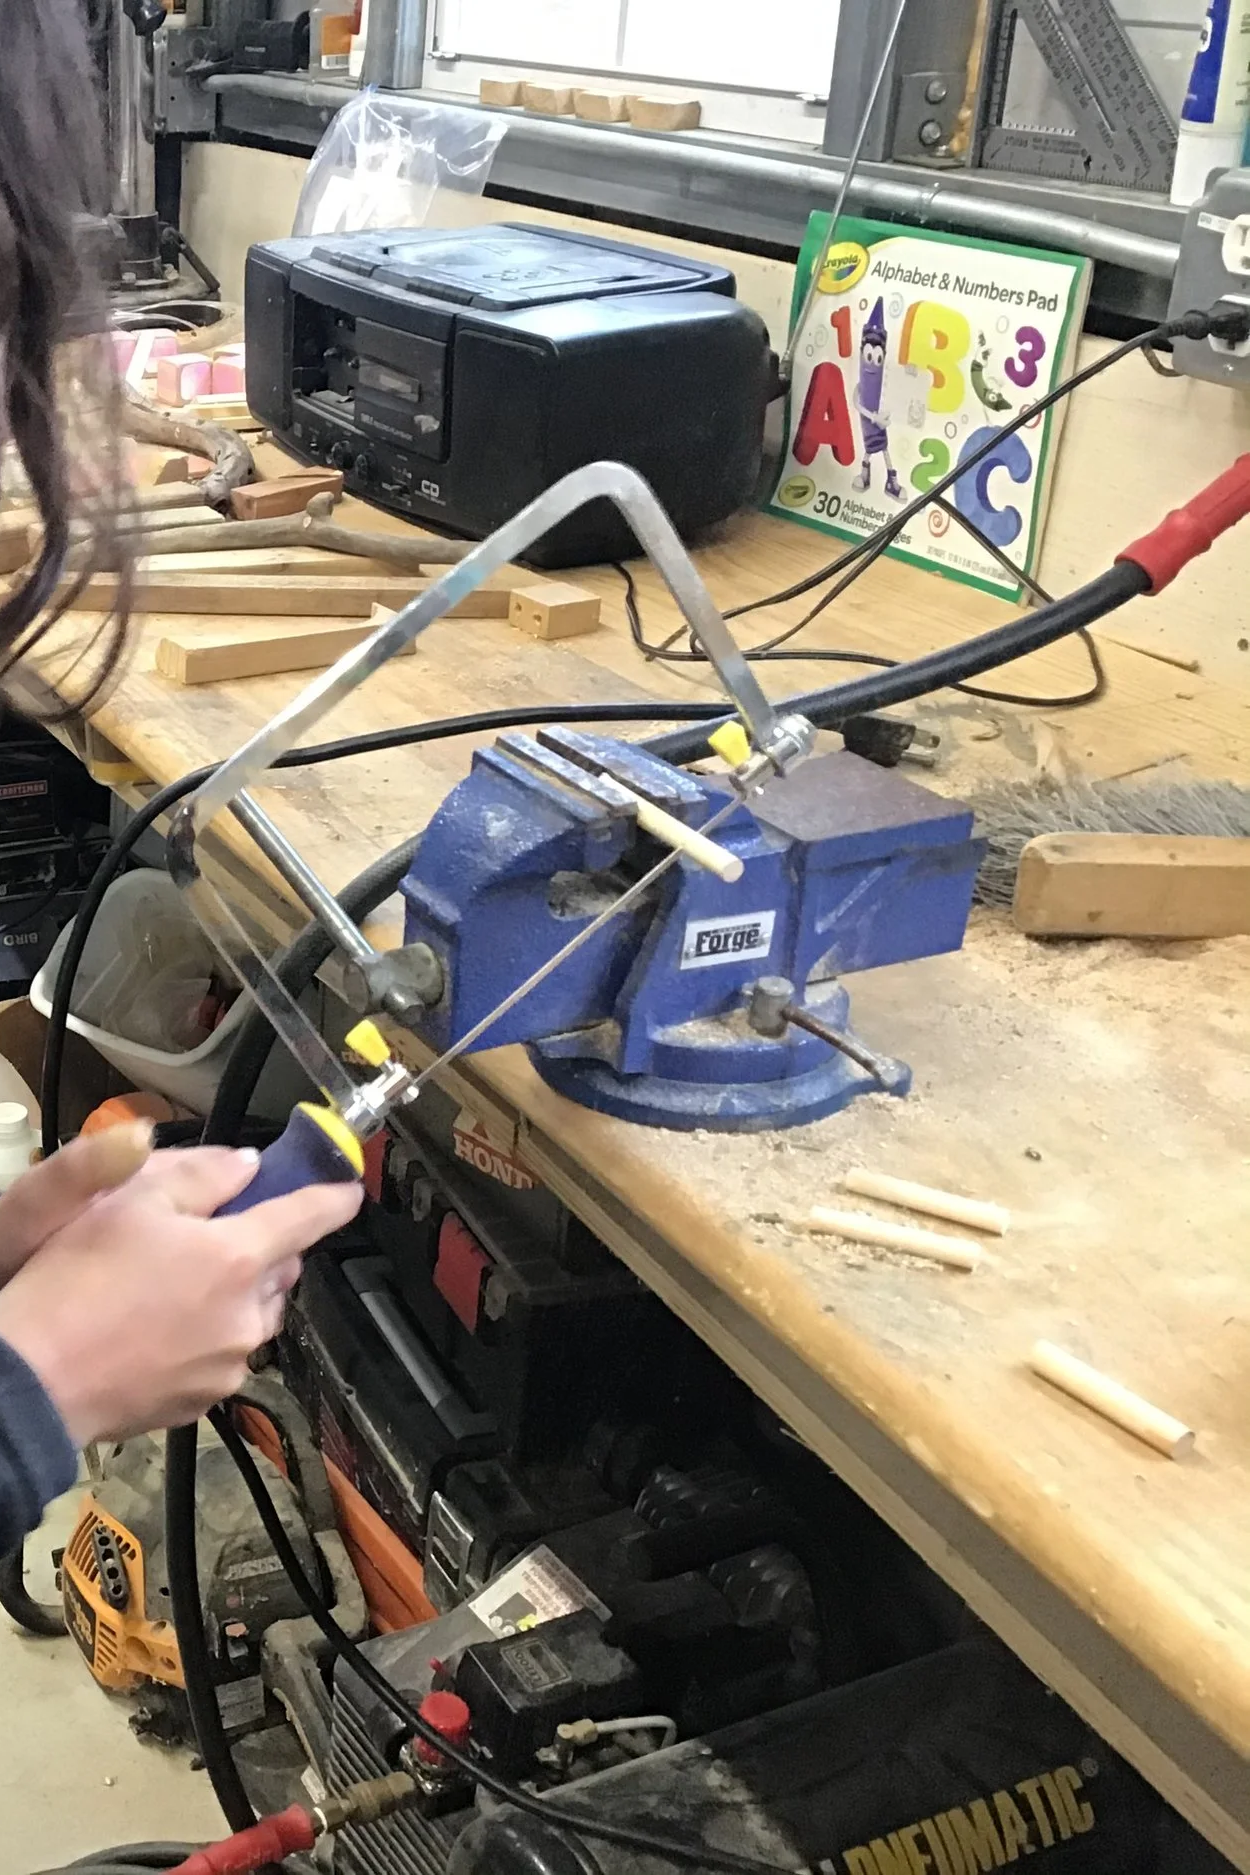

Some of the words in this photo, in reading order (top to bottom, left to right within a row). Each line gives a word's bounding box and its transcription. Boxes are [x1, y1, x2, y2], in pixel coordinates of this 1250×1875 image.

[822, 253, 860, 269] rayola
[871, 261, 938, 288] Alphabet
[938, 272, 951, 291] &
[952, 275, 1025, 306] Numbers
[1026, 289, 1059, 313] Pad
[831, 305, 853, 358] 1
[898, 300, 971, 413] B
[1004, 326, 1046, 388] 3
[792, 361, 855, 466] A
[911, 437, 951, 493] 2
[954, 424, 1033, 547] C
[813, 491, 842, 518] 30
[843, 499, 886, 522] Alphabet
[695, 928, 760, 956] Forge
[453, 1132, 535, 1190] HOND
